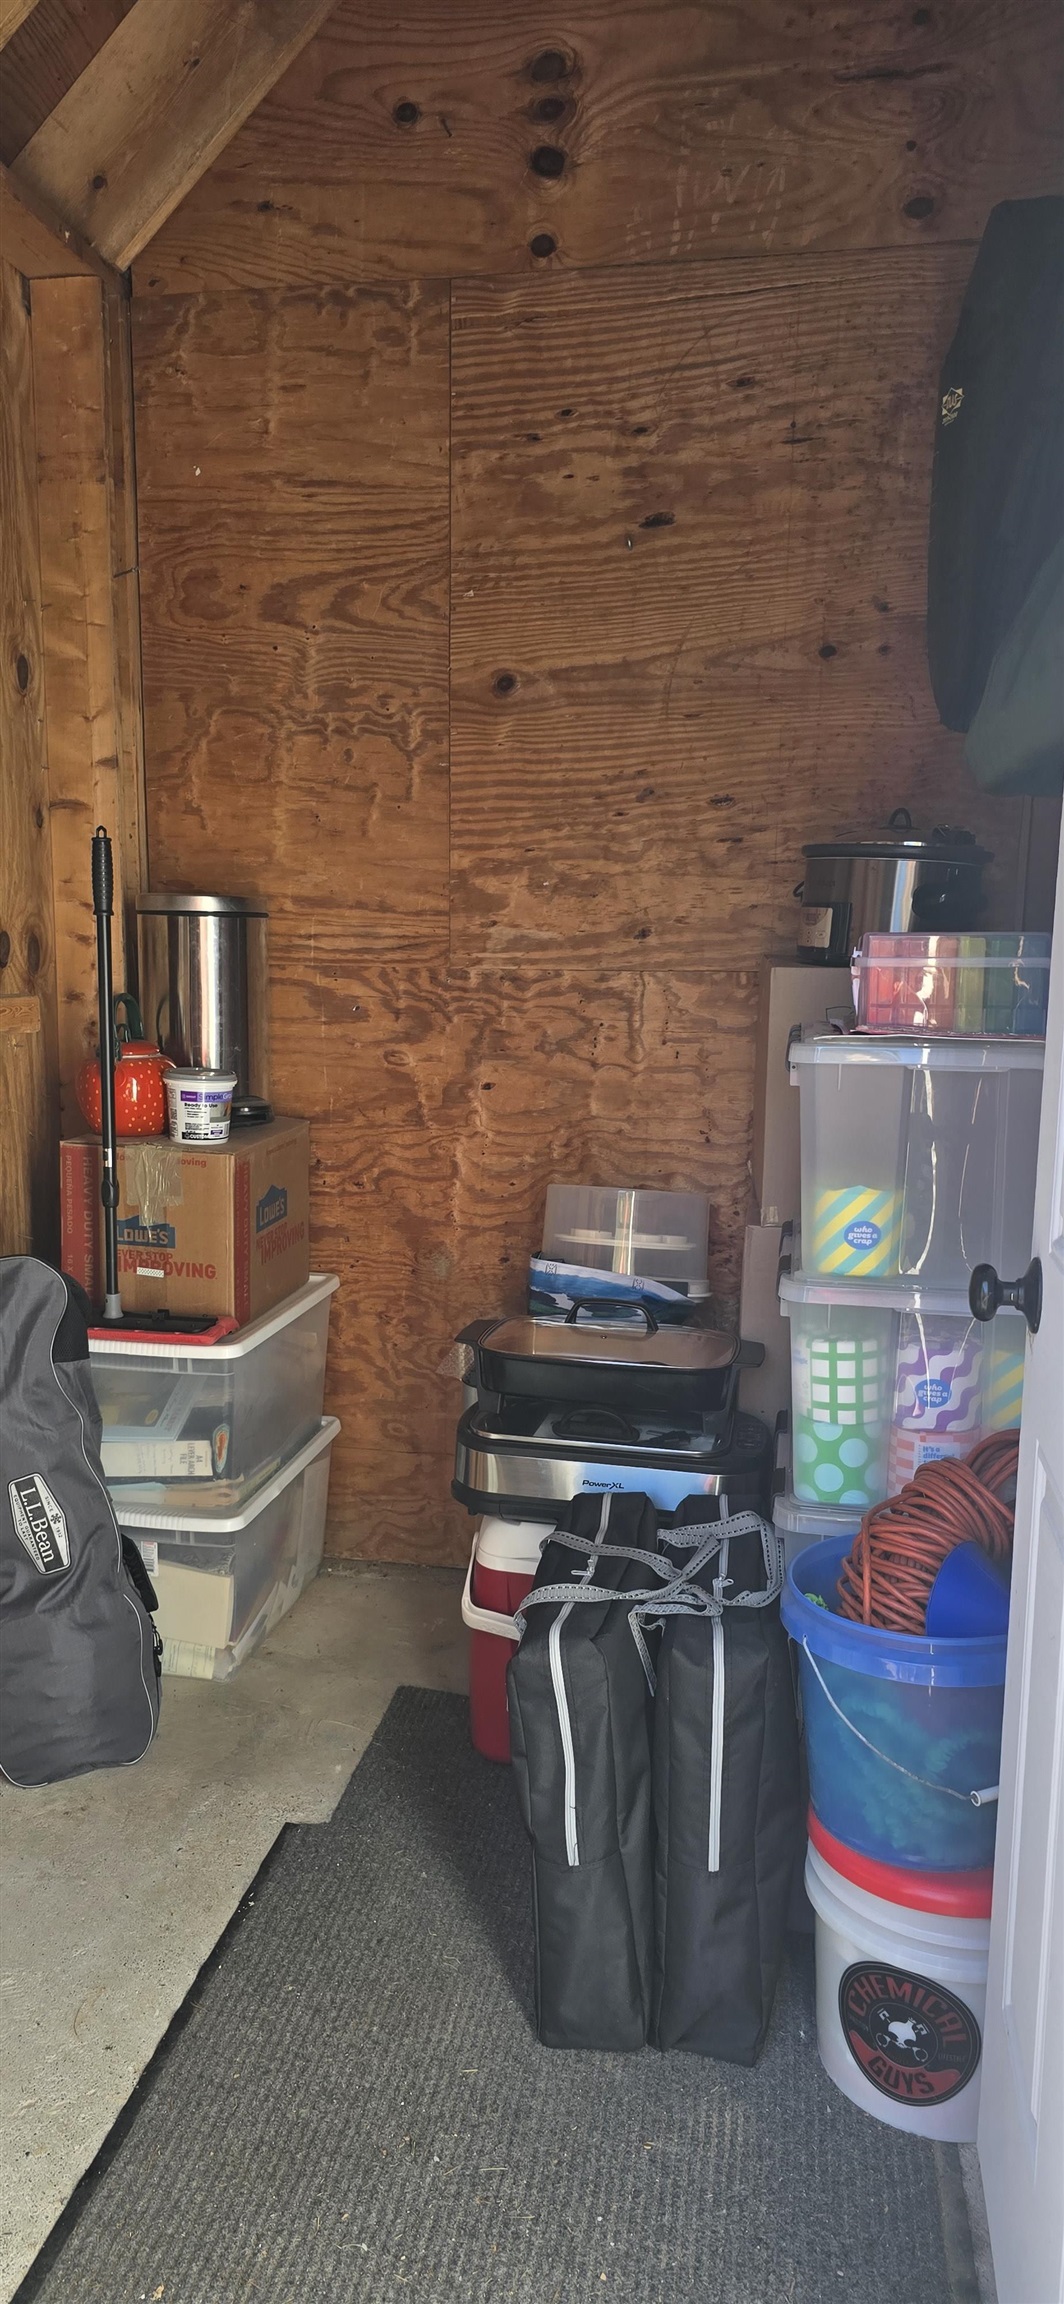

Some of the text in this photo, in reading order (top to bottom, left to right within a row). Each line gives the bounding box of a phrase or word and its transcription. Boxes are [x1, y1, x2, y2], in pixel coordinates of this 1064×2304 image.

[83, 1156, 92, 1205] HEAVY
[259, 1195, 285, 1226] LOWE'S
[84, 1211, 94, 1249] DUTY
[117, 1225, 169, 1244] LOWE'S
[117, 1248, 174, 1262] EVER STOP
[45, 1496, 54, 1512] SINCE
[582, 1480, 624, 1490] PowerXL
[14, 1494, 40, 1560] EQUIPMENT GUARANTEED
[20, 1487, 54, 1562] L.L.Bean
[848, 1974, 967, 2048] CHEMICAL
[868, 2056, 934, 2095] GUYS
